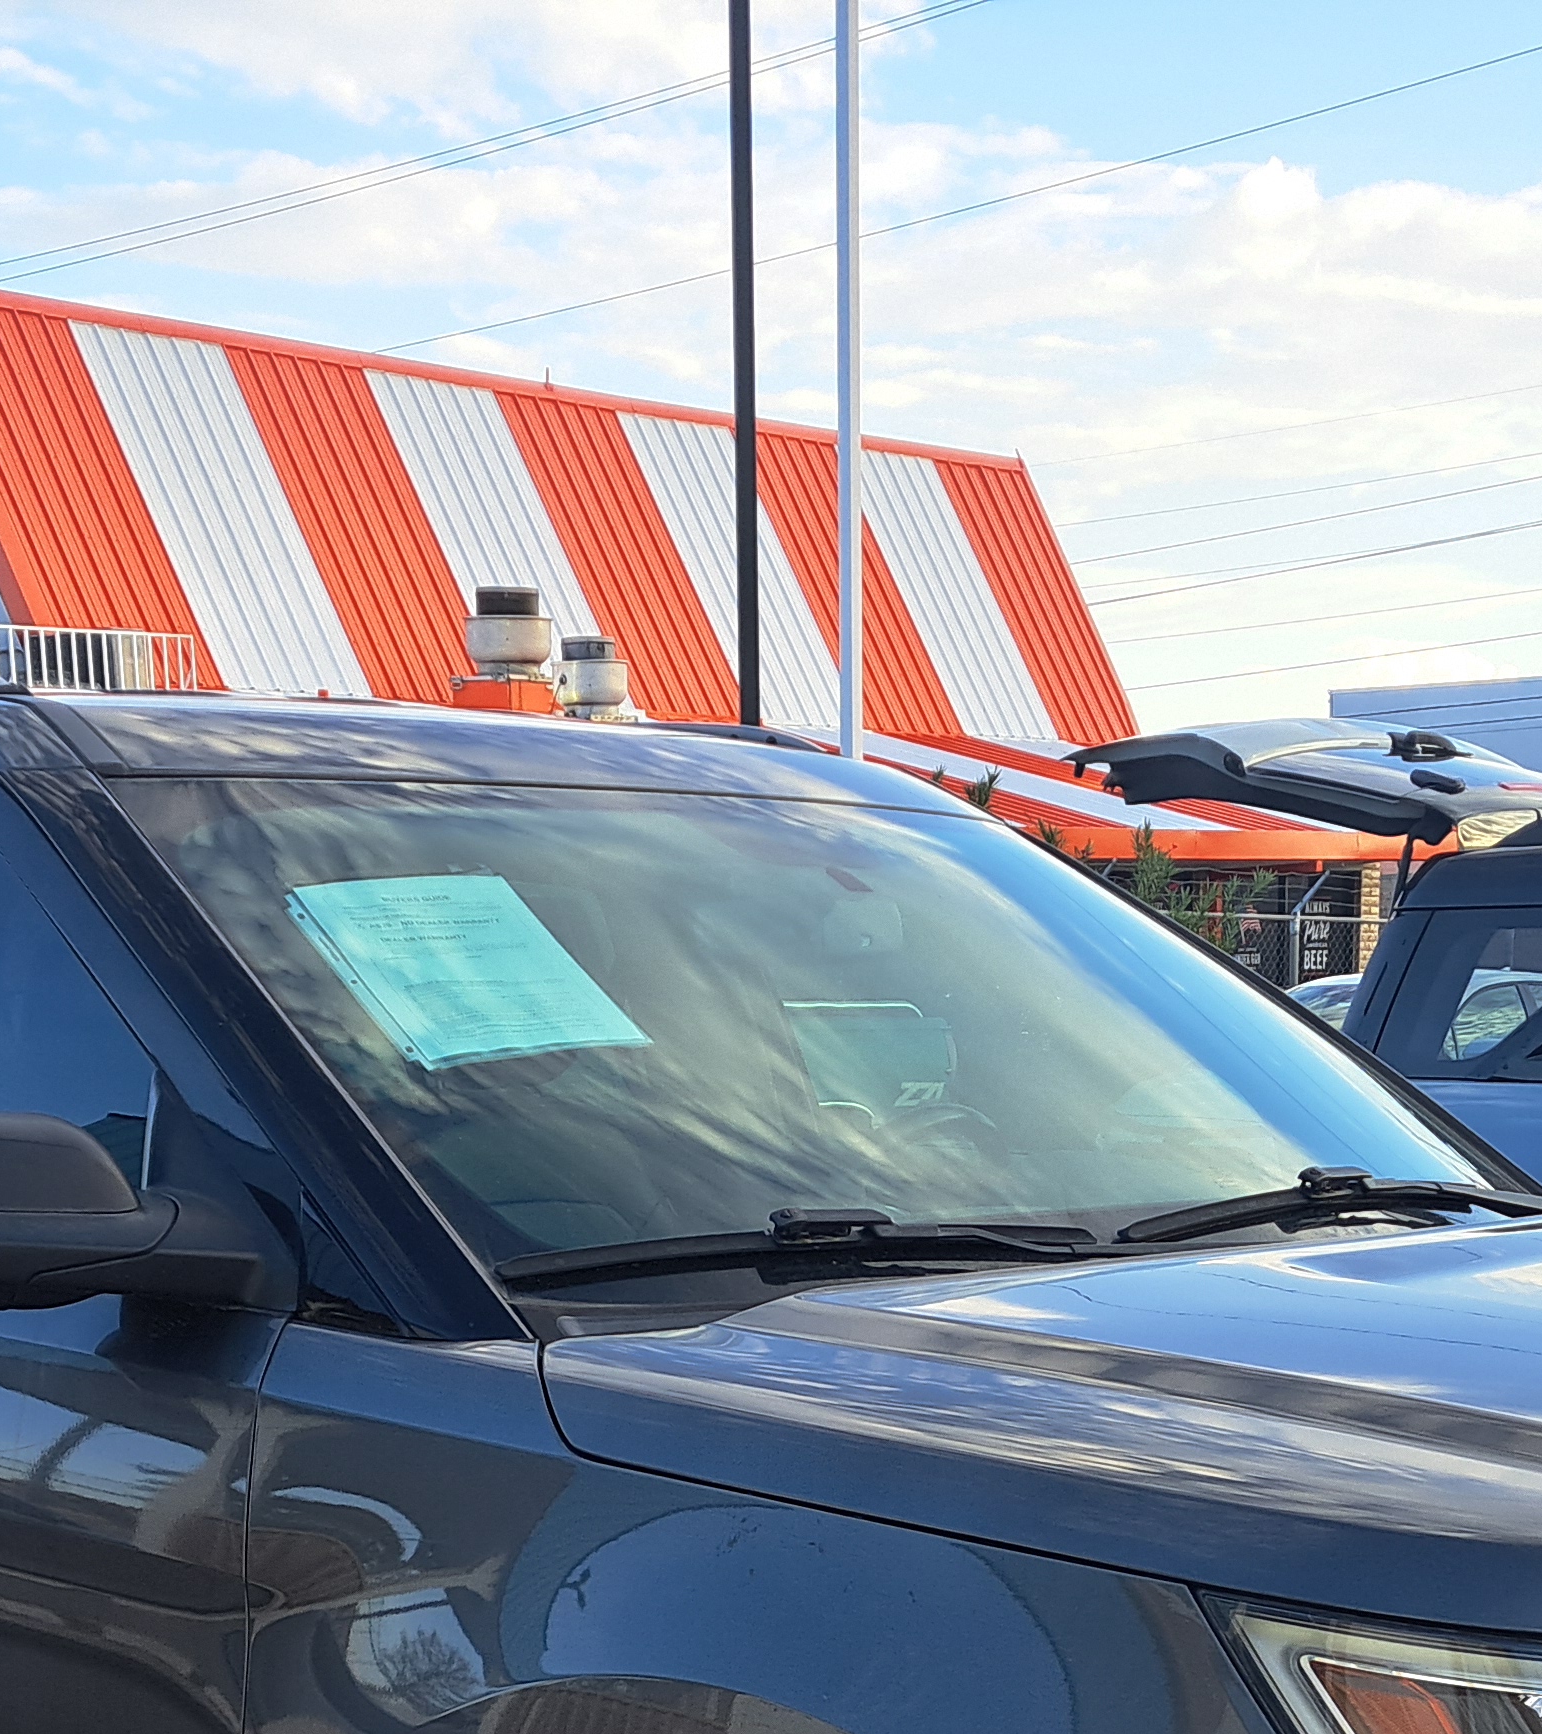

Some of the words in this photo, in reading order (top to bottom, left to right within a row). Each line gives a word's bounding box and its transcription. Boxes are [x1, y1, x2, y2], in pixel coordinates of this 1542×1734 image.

[1304, 901, 1331, 914] ALWAYS
[1303, 920, 1331, 945] Pure
[1303, 950, 1328, 970] BEEF
